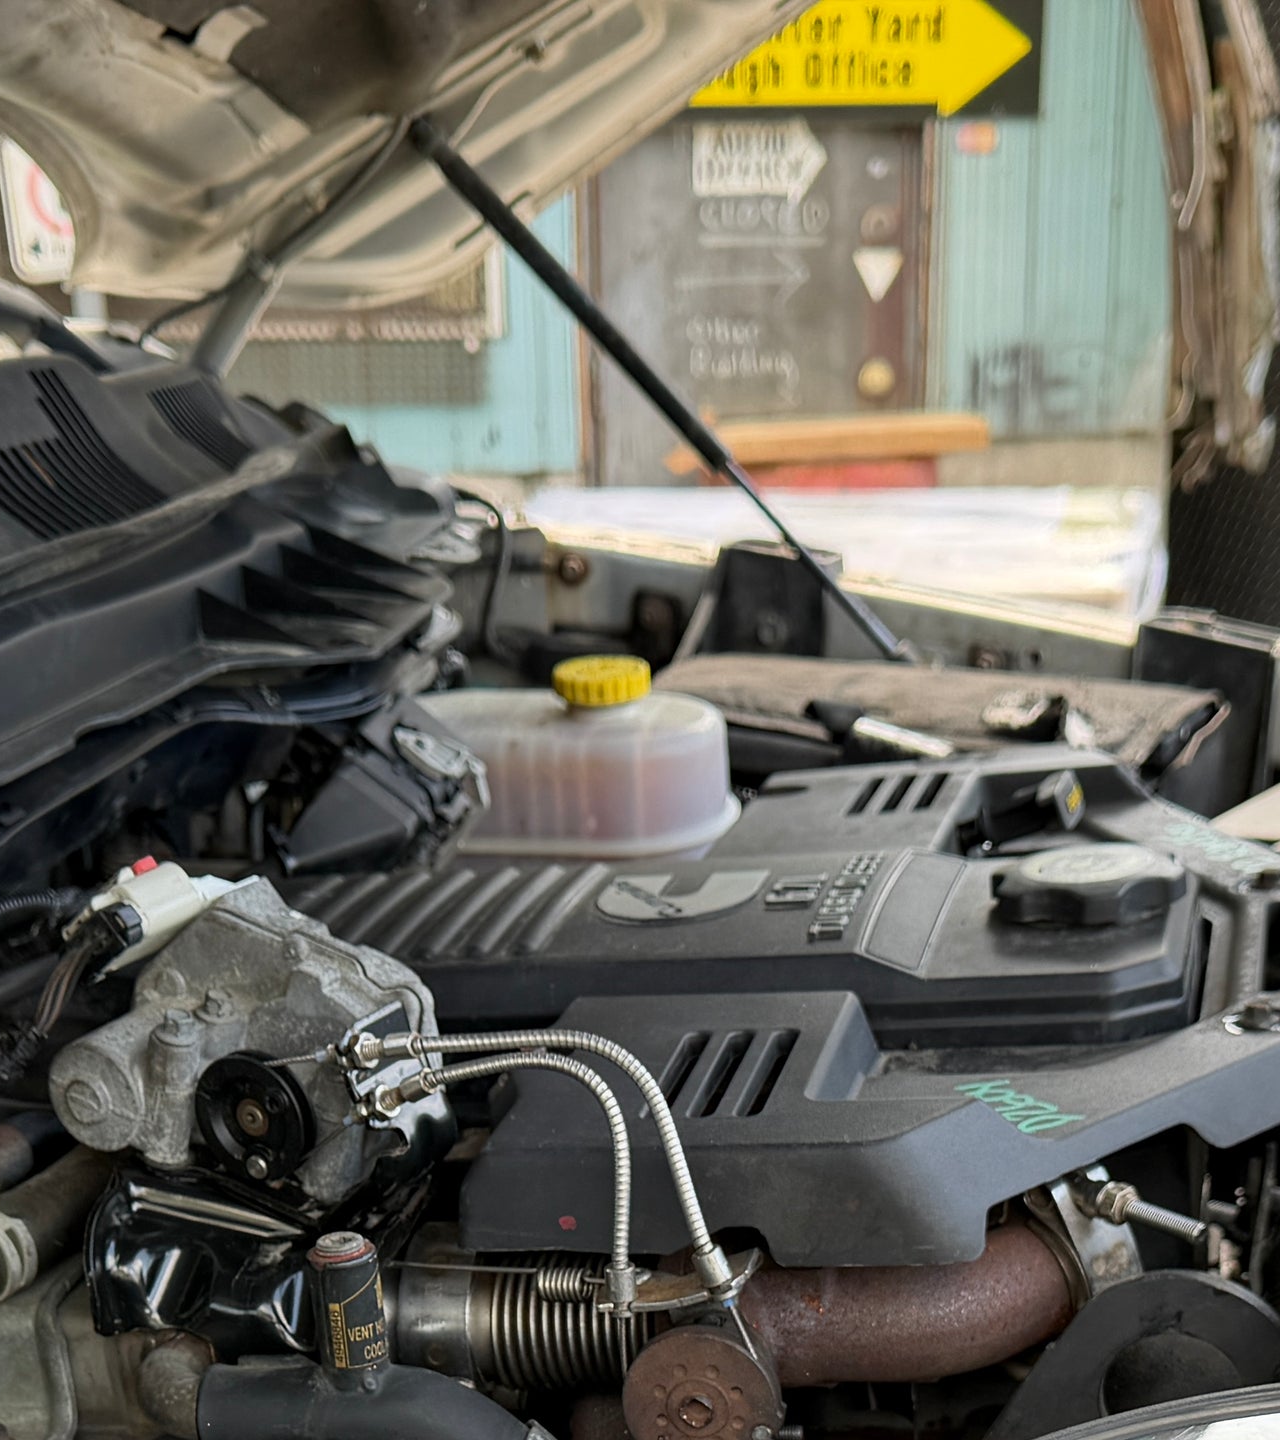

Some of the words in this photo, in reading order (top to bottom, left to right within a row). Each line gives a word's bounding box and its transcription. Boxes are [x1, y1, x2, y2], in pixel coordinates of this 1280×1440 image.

[867, 5, 943, 43] Yard
[805, 53, 912, 87] Office
[348, 1323, 374, 1342] VENT
